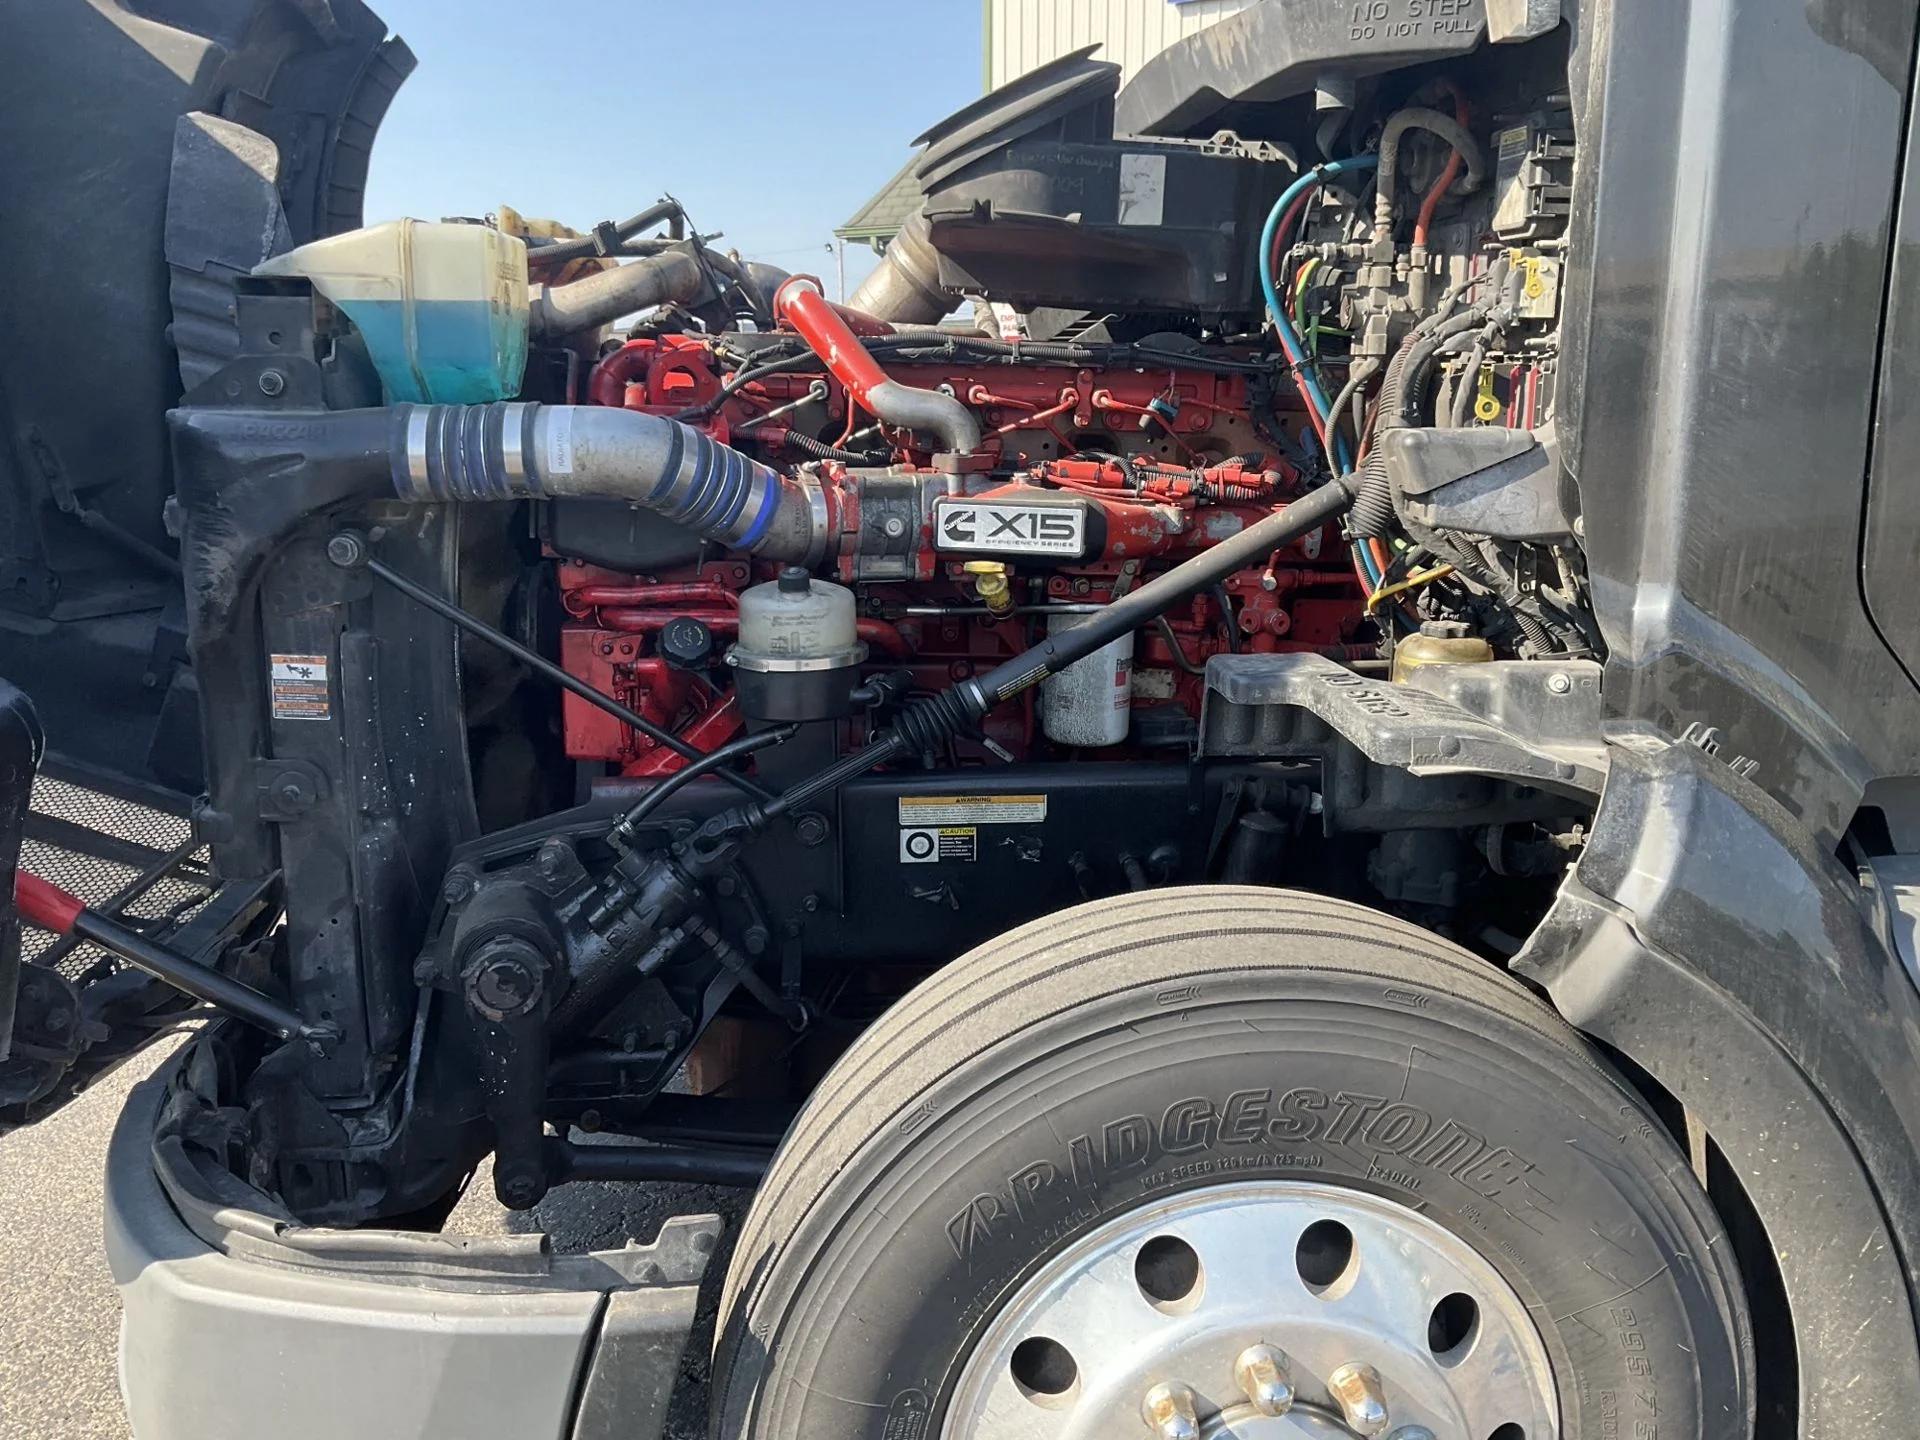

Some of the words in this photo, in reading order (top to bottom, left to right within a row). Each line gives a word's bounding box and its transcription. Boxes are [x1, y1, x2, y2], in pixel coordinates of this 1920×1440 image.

[1353, 1, 1389, 22] NO
[1409, 0, 1470, 17] STEP
[1350, 26, 1375, 40] DO
[1386, 22, 1421, 37] NOT
[1433, 19, 1475, 33] PULL
[987, 511, 1075, 540] X15
[1171, 1160, 1212, 1178] SPEED
[1371, 1166, 1421, 1189] RADIAL
